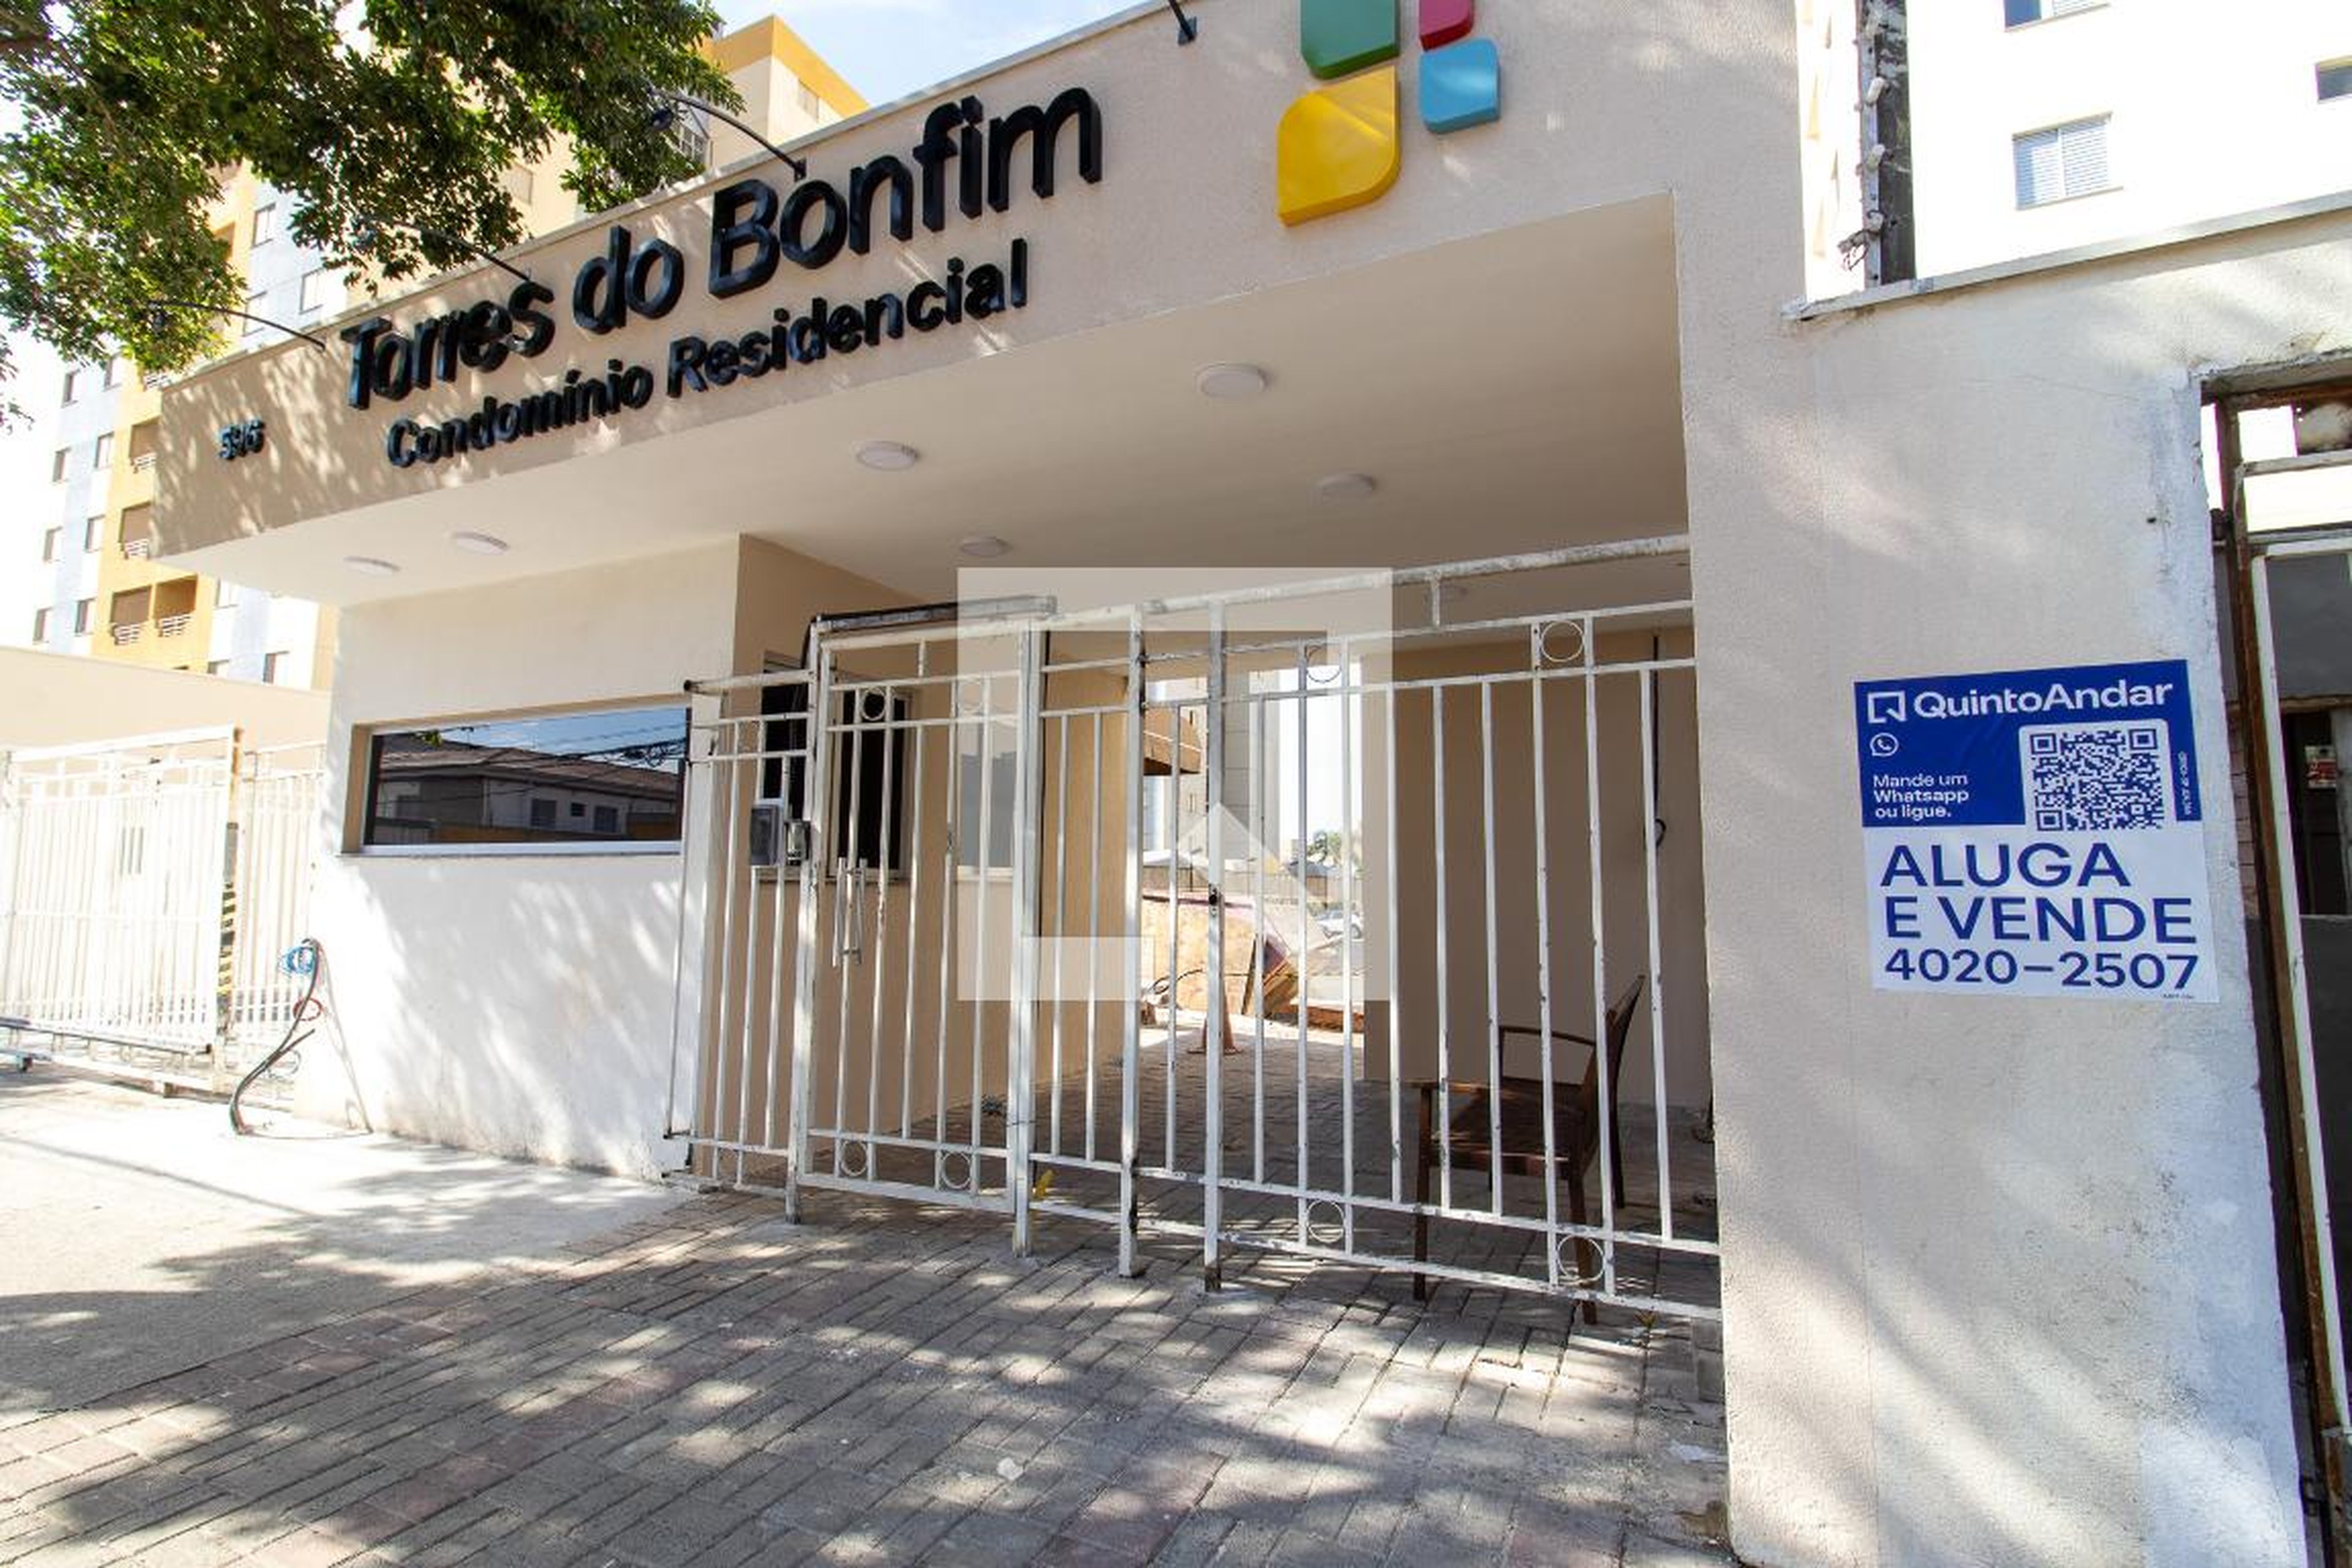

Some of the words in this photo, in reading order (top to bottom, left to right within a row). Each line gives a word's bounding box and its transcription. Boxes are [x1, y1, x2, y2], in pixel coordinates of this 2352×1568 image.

[341, 281, 554, 409] Torres
[573, 224, 685, 334] do
[709, 87, 1102, 299] Bonfim
[666, 238, 1028, 398] Residencial
[1913, 679, 2174, 719] QuintoAndar
[1872, 774, 1935, 788] Mande
[1939, 774, 1969, 786] um
[1873, 789, 1970, 805] Whatsapp
[1875, 807, 1898, 818] ou
[1901, 804, 1952, 822] ligue.
[1880, 842, 2131, 888] ALUGA
[1885, 896, 1921, 938] E
[1937, 896, 2197, 944] VENDE
[1884, 948, 2199, 990] 4020-2507
